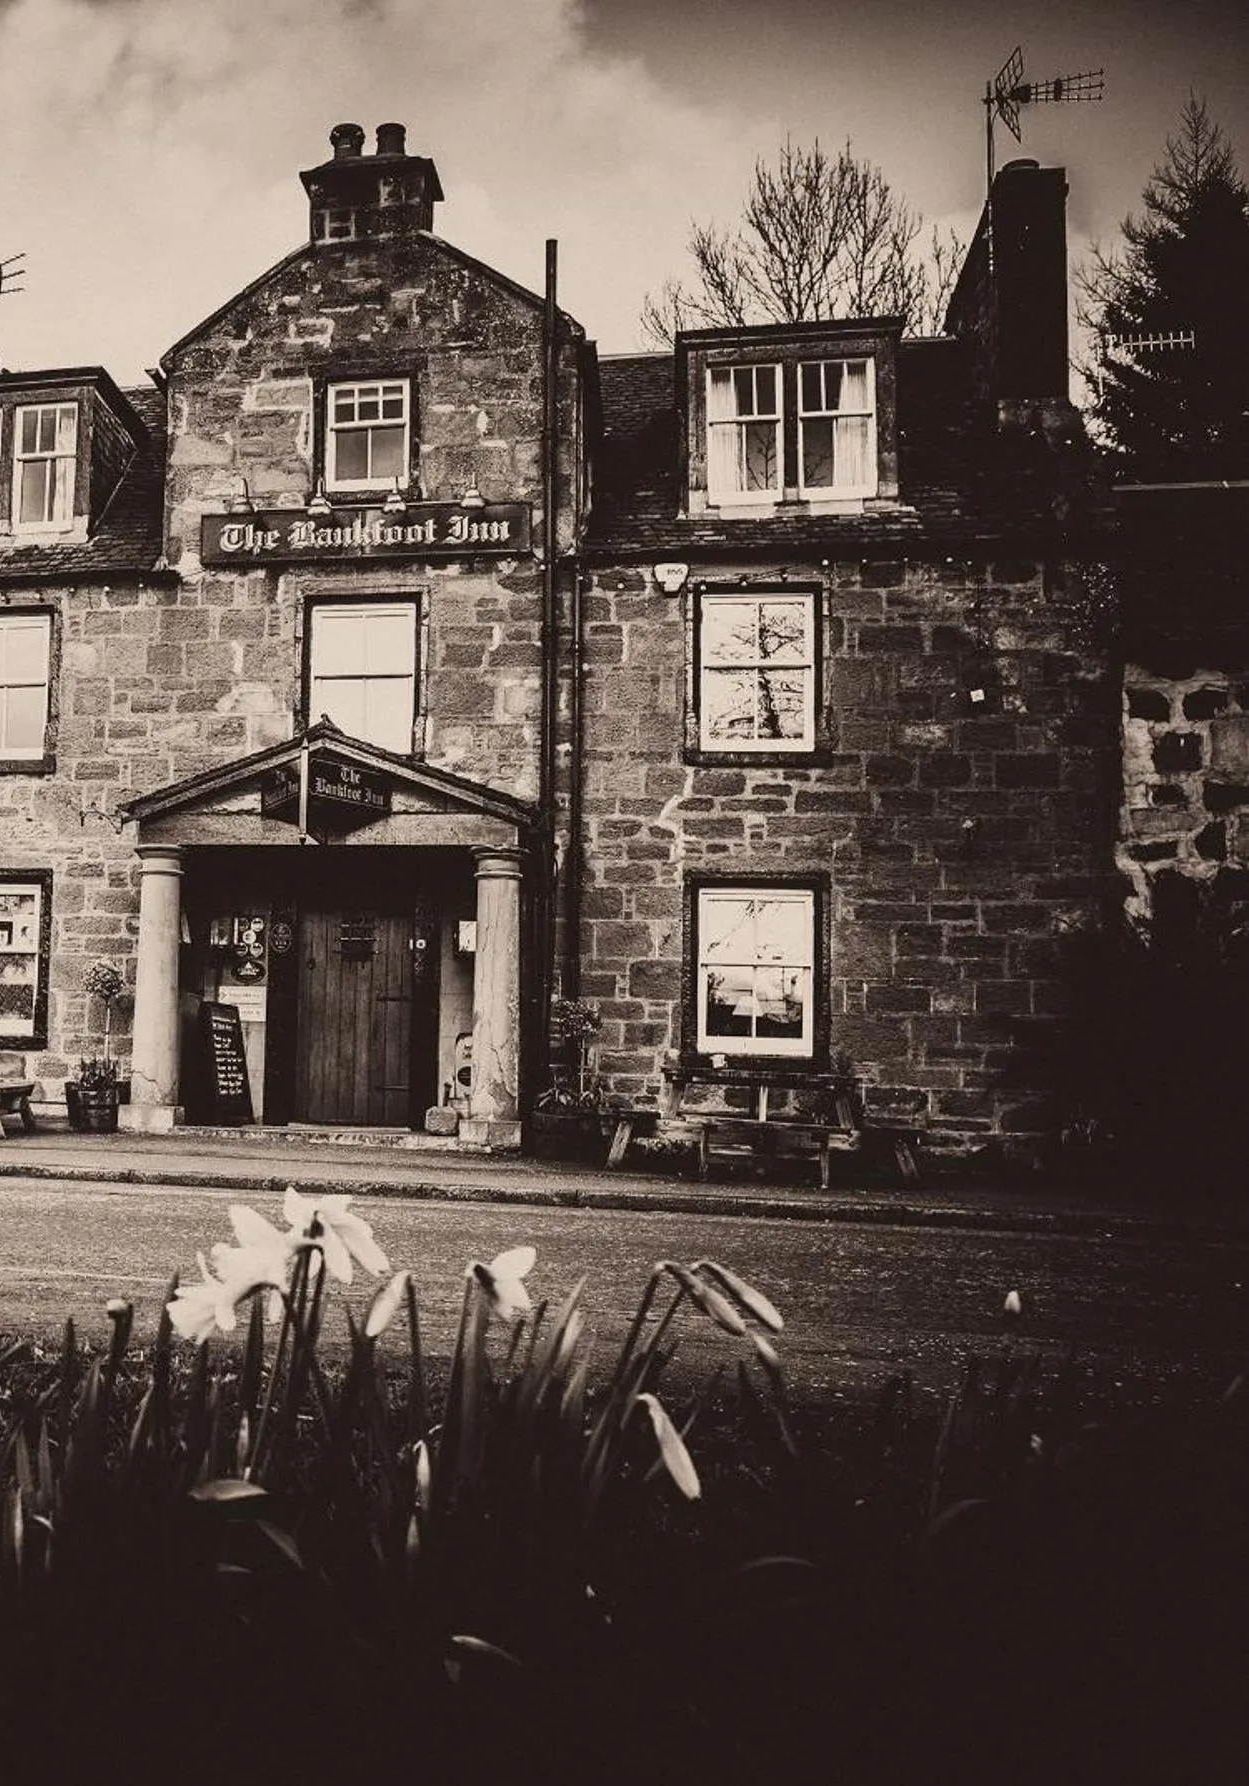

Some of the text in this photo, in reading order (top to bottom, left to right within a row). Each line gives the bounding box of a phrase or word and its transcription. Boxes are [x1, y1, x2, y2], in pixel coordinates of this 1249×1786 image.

[220, 515, 511, 555] The Bankfoot Inn
[340, 766, 362, 784] The
